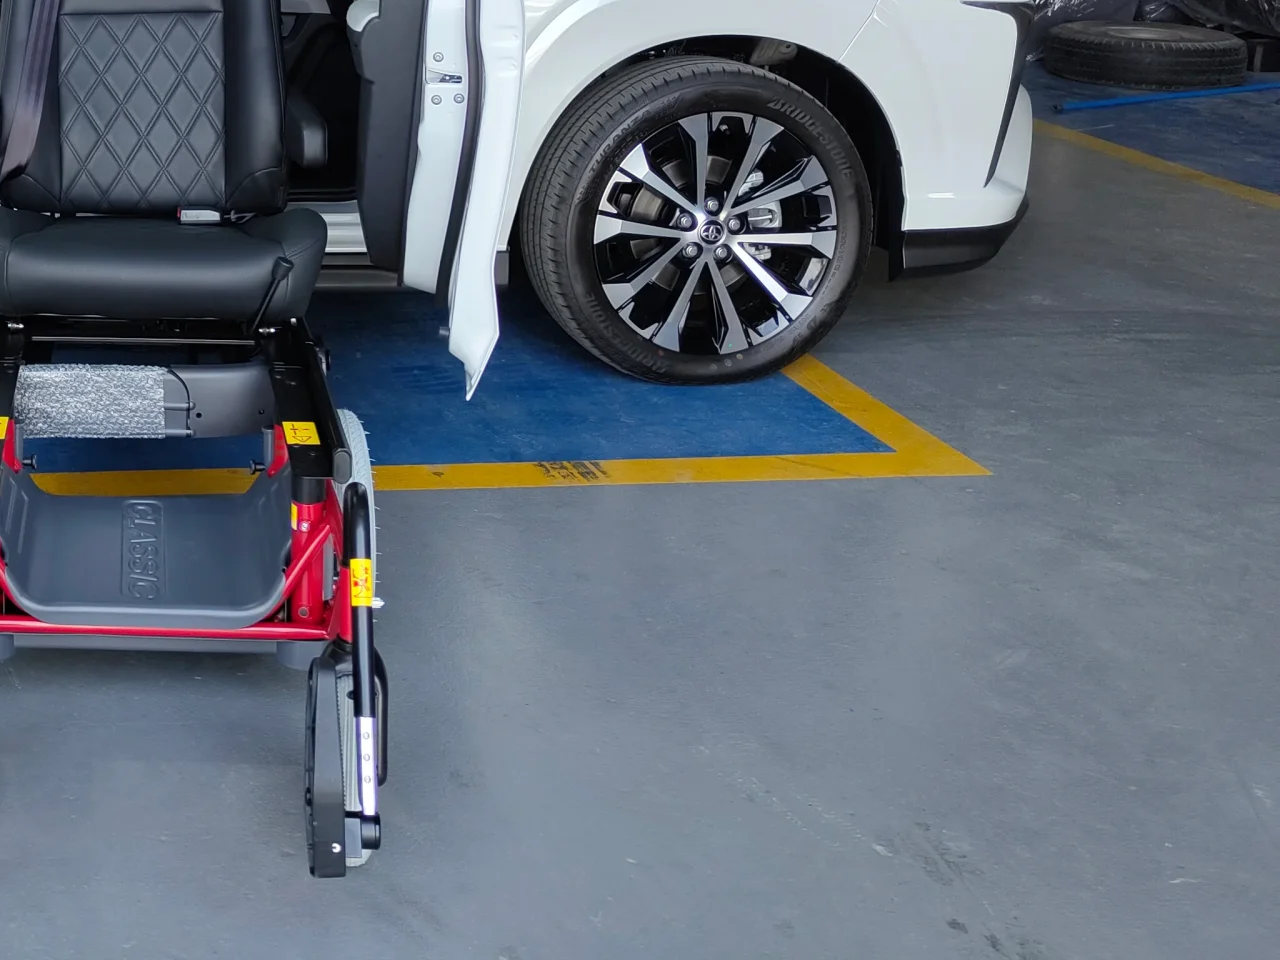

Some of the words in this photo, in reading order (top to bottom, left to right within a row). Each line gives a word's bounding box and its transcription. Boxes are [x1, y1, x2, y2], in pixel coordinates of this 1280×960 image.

[588, 108, 652, 174] TURANZA
[766, 95, 855, 180] BRIDGESTONE
[127, 504, 160, 600] CLASSIC
